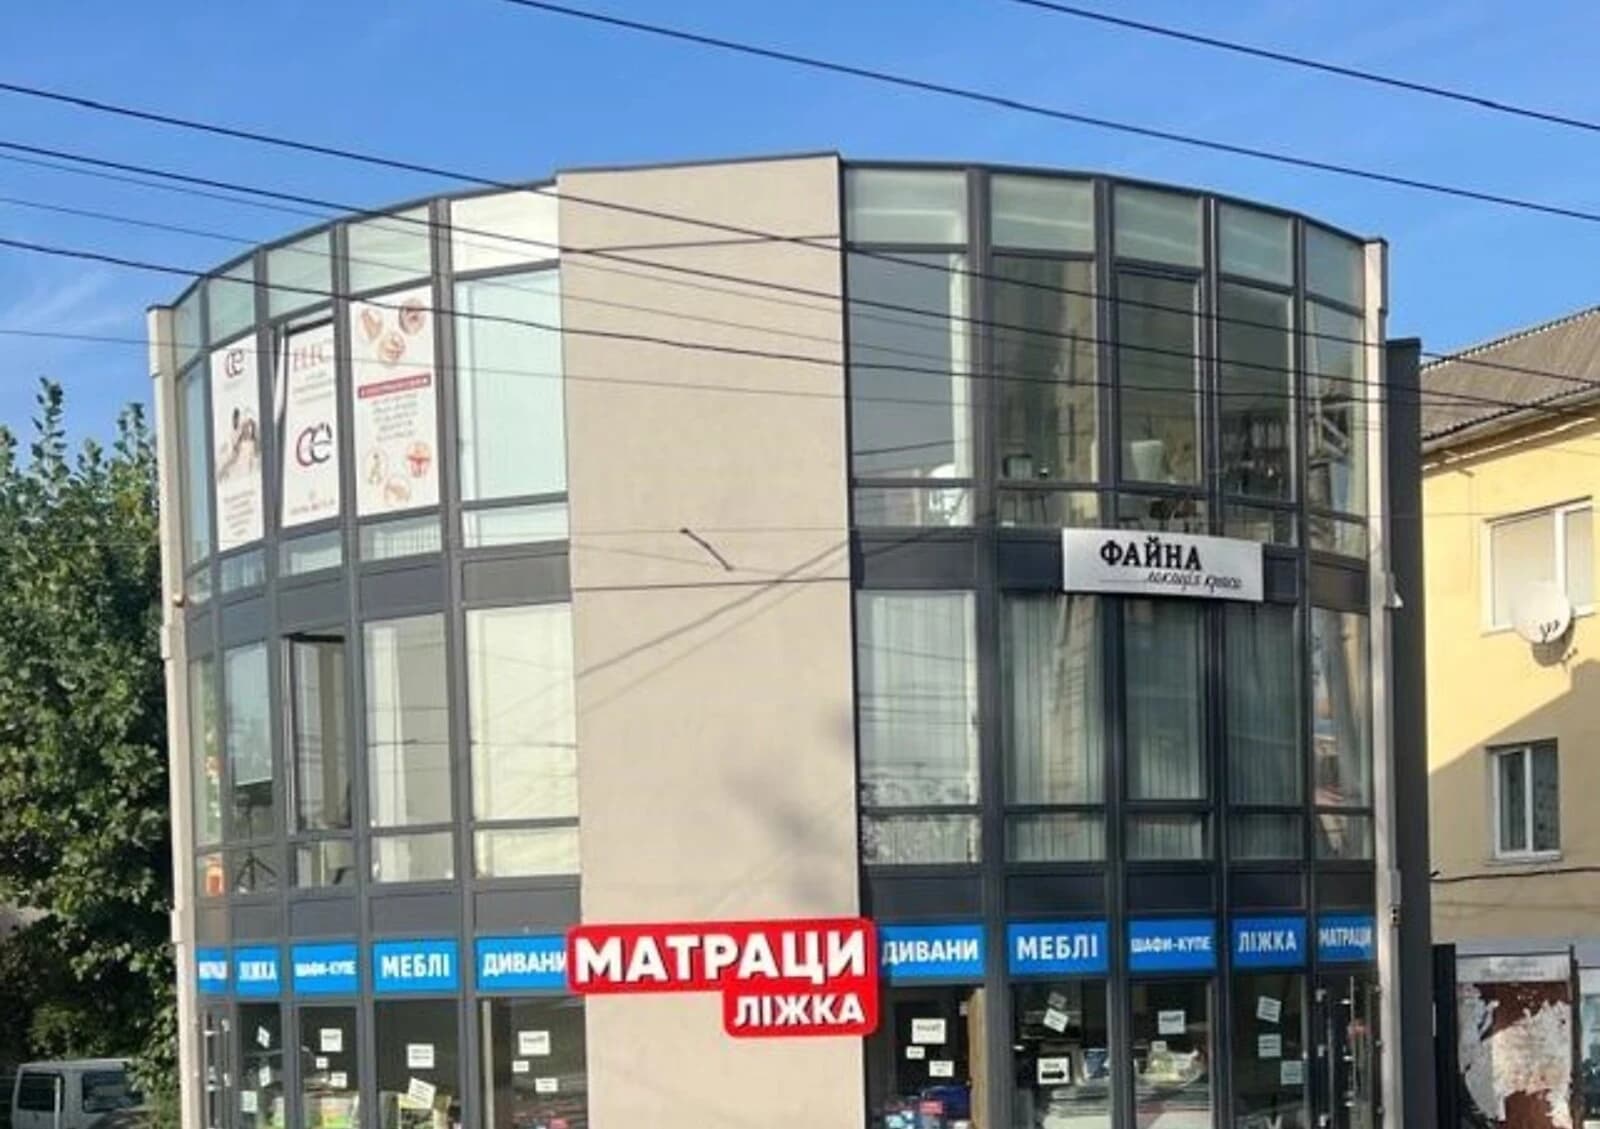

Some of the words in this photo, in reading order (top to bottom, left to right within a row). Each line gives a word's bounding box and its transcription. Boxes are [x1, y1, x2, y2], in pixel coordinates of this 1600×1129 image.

[1100, 536, 1202, 570] ФАЙНА
[1016, 934, 1098, 961] МЕБЛІ
[1131, 936, 1212, 953] ШАФИ-КУПЕ
[1238, 930, 1297, 952] ЛІЖКА
[1319, 926, 1372, 948] МАТРАЦИ
[381, 953, 450, 979] МЕБЛІ
[574, 930, 867, 984] МАТРАЦИ
[881, 939, 978, 966] ДИВАНИ
[734, 993, 865, 1027] ЛІЖКА
